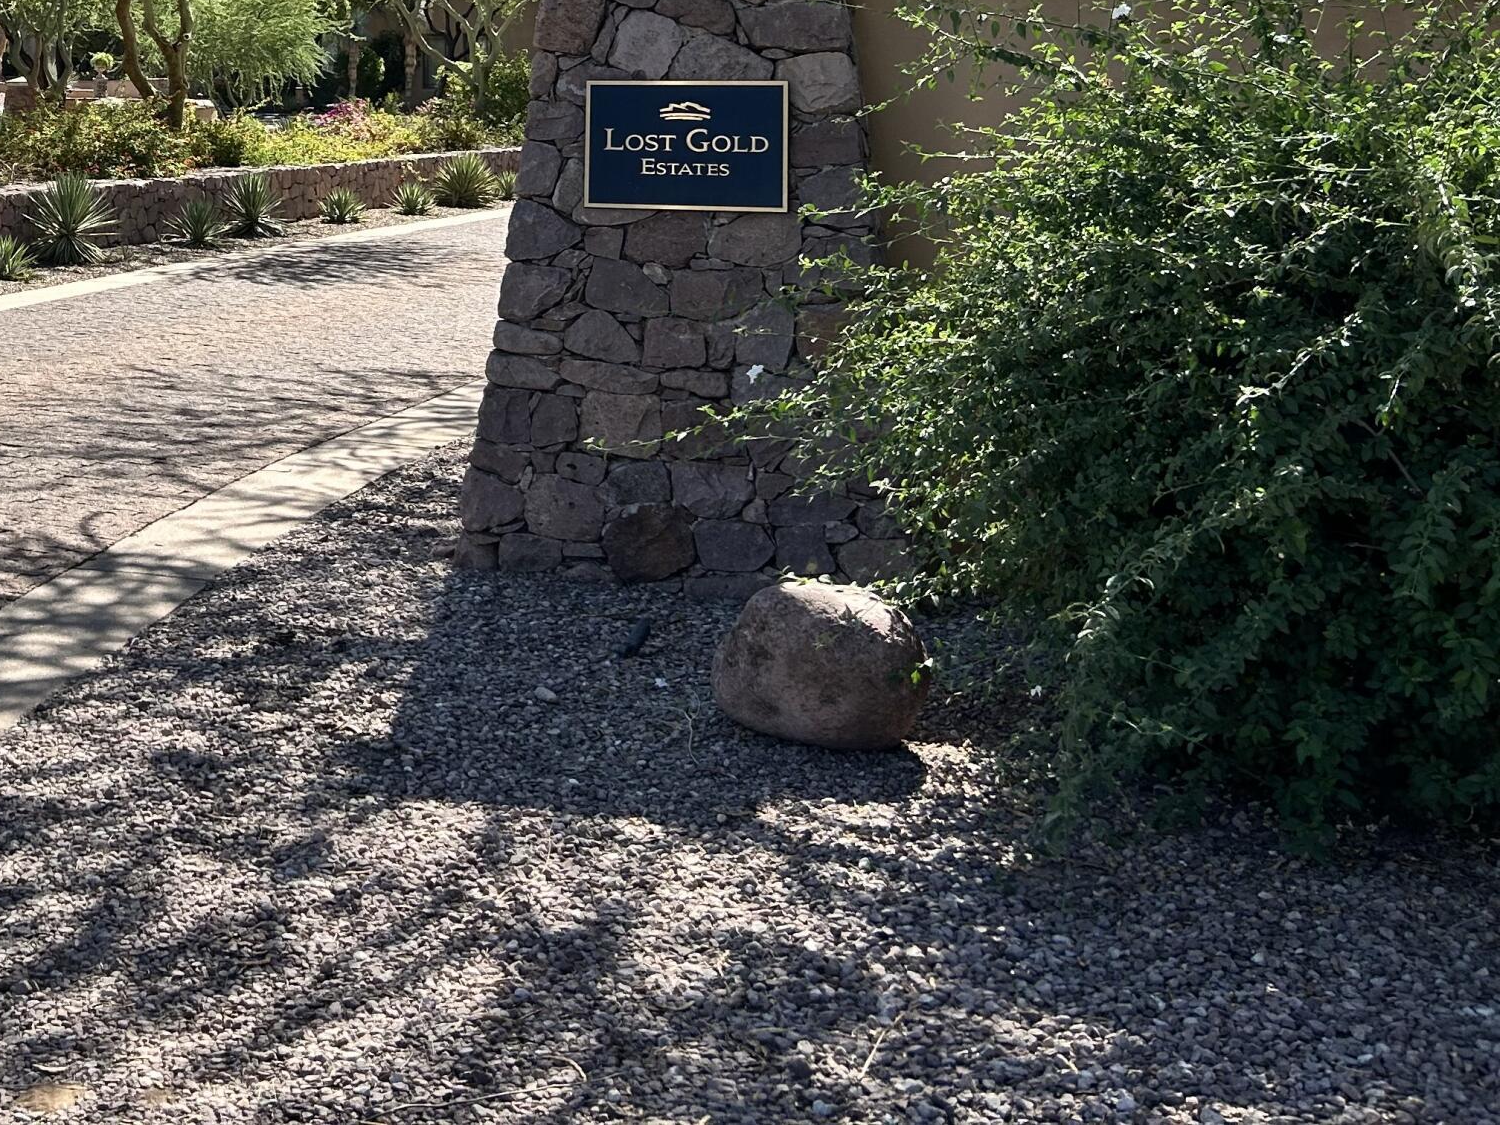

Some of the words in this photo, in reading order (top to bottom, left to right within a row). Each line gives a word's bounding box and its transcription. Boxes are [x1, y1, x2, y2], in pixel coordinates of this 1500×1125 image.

[603, 127, 677, 152] LOST
[685, 128, 770, 153] GOLD
[640, 157, 730, 177] ESTATES
